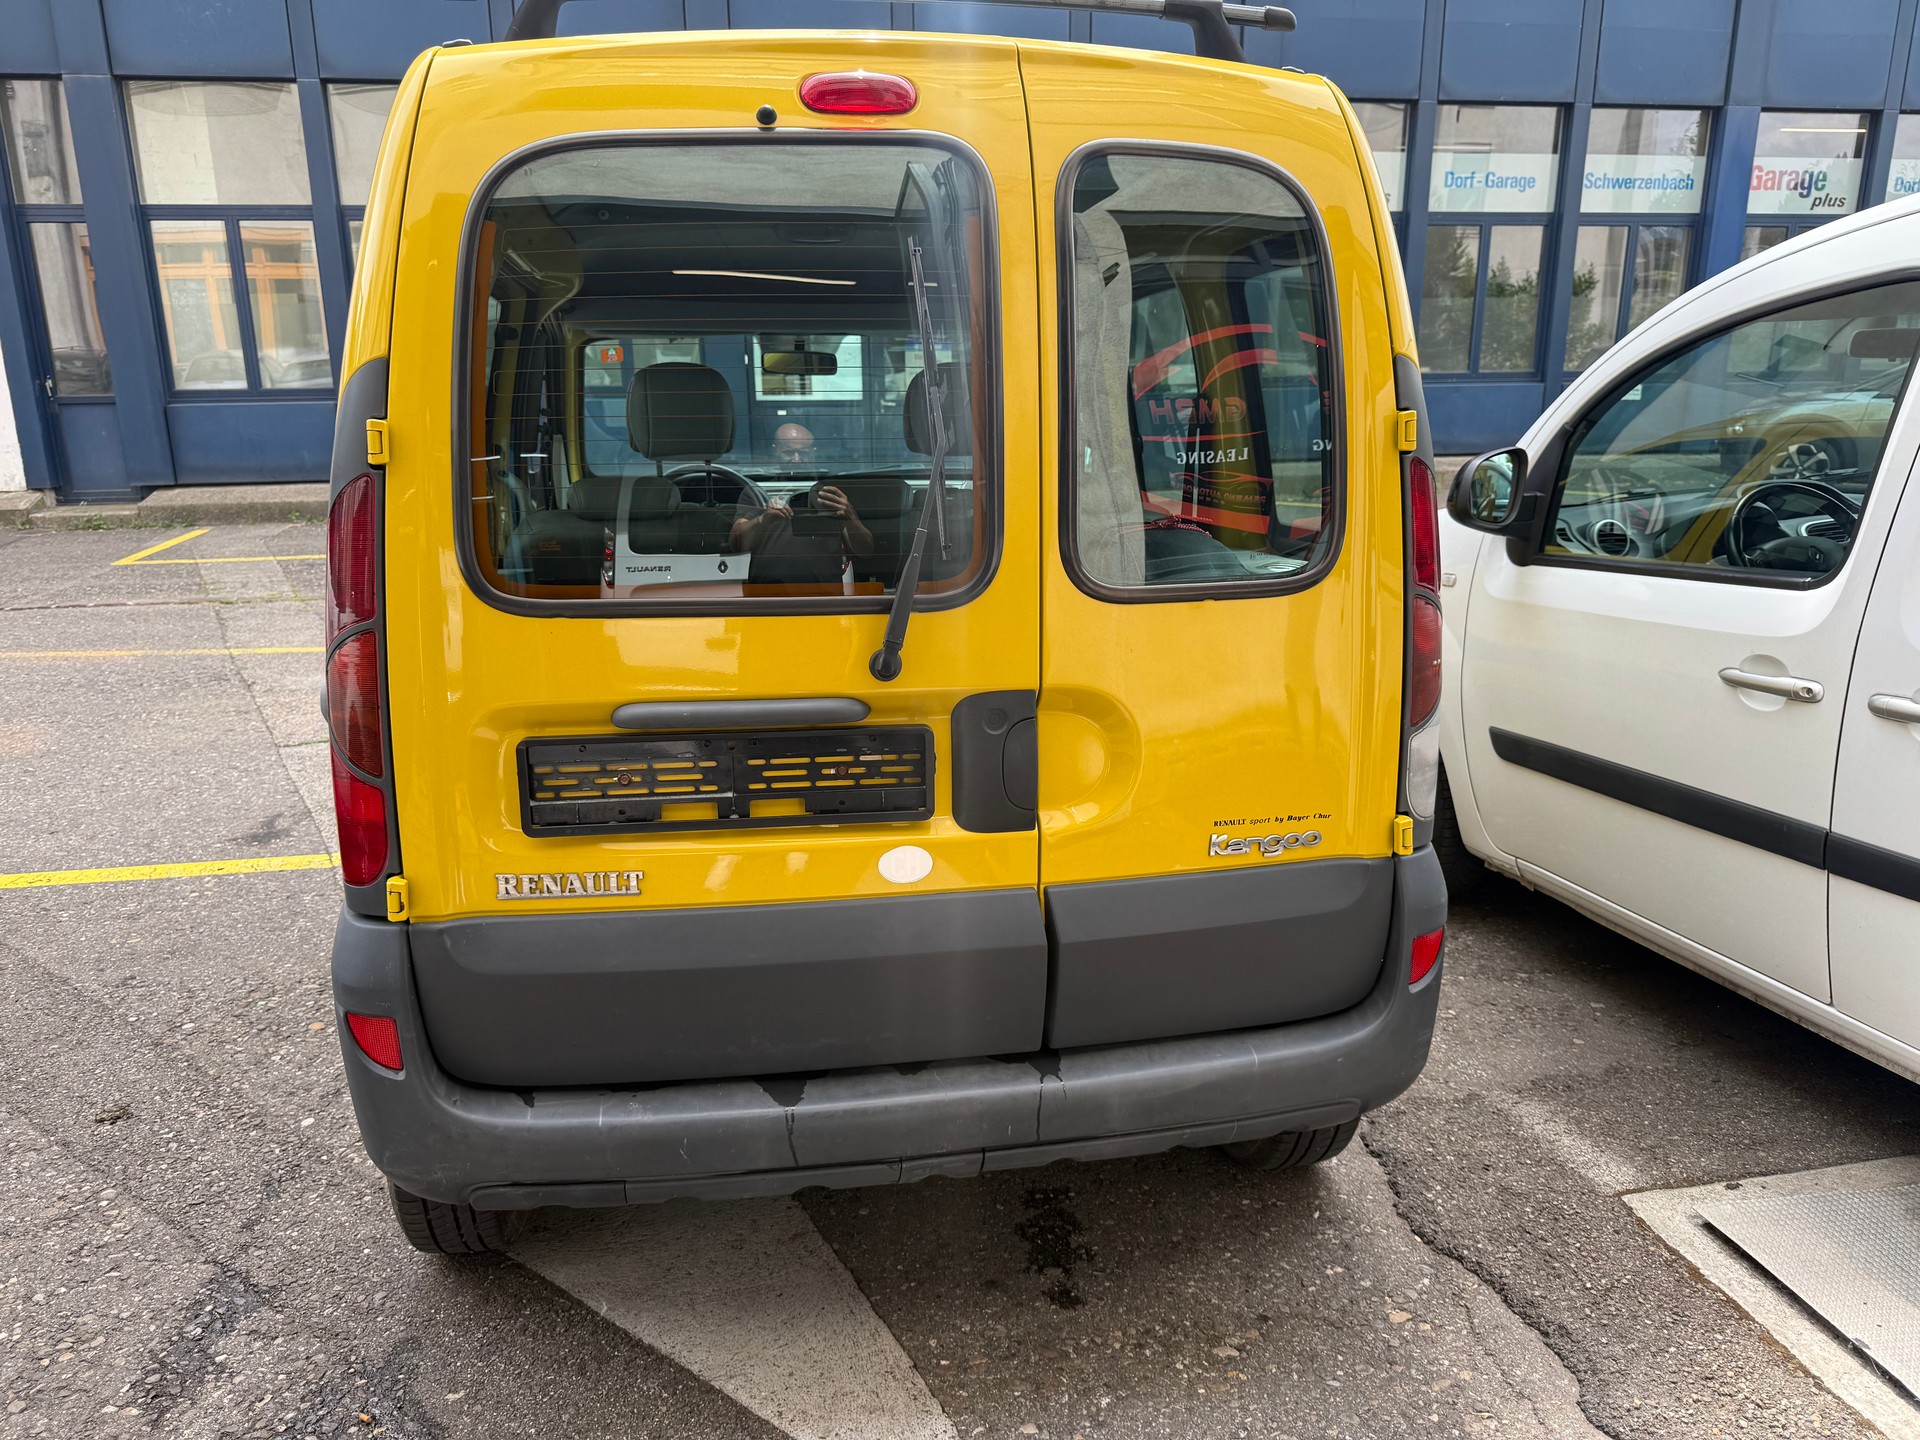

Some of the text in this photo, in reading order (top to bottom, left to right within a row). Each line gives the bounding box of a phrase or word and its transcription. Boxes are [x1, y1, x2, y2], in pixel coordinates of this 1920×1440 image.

[1583, 171, 1695, 191] Schwerzenbach
[1749, 164, 1828, 199] Garage
[1809, 193, 1847, 211] plus
[1213, 812, 1332, 827] RENAULT sport by Bayer Chur
[1209, 830, 1323, 858] Kangoo
[495, 871, 644, 900] RENAULT
